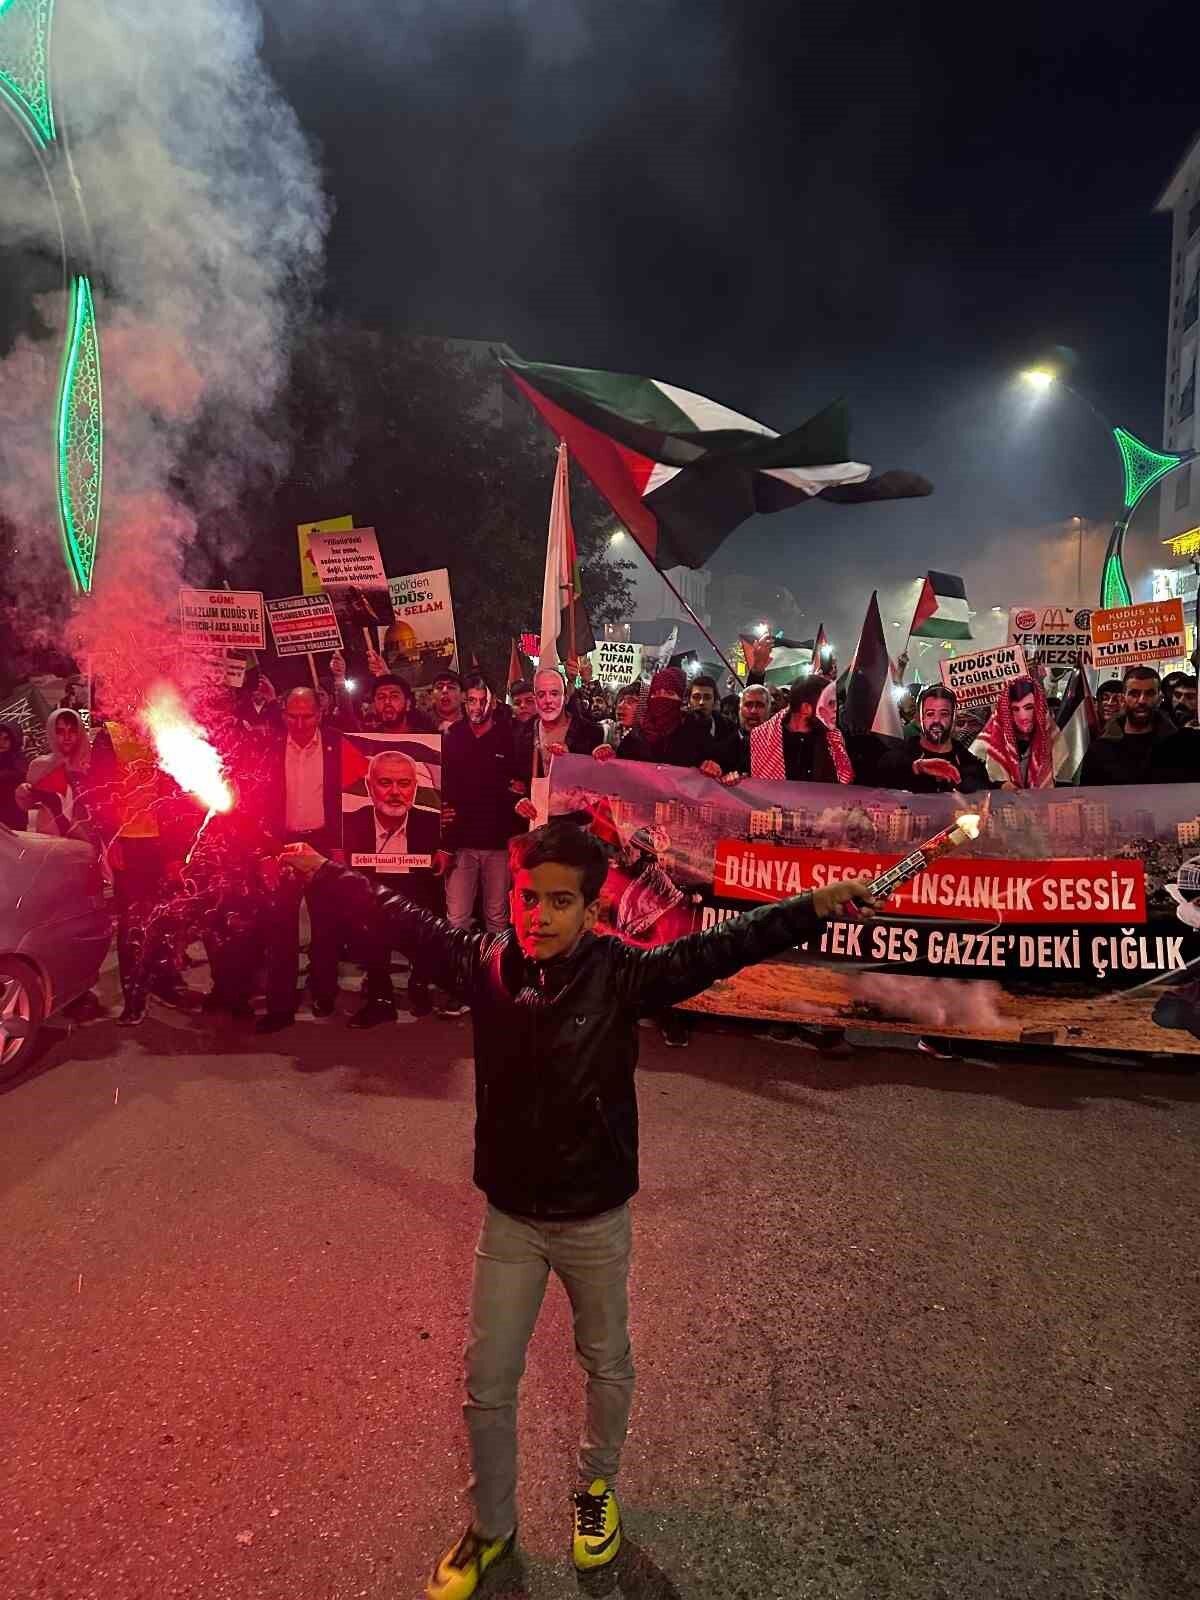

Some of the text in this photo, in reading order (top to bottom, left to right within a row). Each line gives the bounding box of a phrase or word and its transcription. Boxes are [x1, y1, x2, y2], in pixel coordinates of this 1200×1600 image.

[221, 605, 247, 619] KUDÜS
[248, 608, 259, 620] VE
[404, 600, 444, 616] SELAM
[250, 621, 260, 633] İLE
[1147, 614, 1177, 625] AKSA
[600, 643, 635, 653] AKSA
[1097, 637, 1180, 656] TÜM İSLAM
[600, 653, 634, 664] TUFANI
[949, 649, 1016, 675] KUDÜS'ÜN
[1024, 647, 1093, 665] LMEZSİN
[599, 663, 633, 674] YIKAR
[950, 662, 1020, 687] ÖZGÜRLÜĞÜ
[725, 852, 801, 894] DÜNYA
[1042, 871, 1137, 911] SESSİZ
[872, 926, 919, 963] SES
[928, 929, 1081, 969] GAZZE'DEKİ
[1092, 927, 1187, 979] ÇIĞLIK
